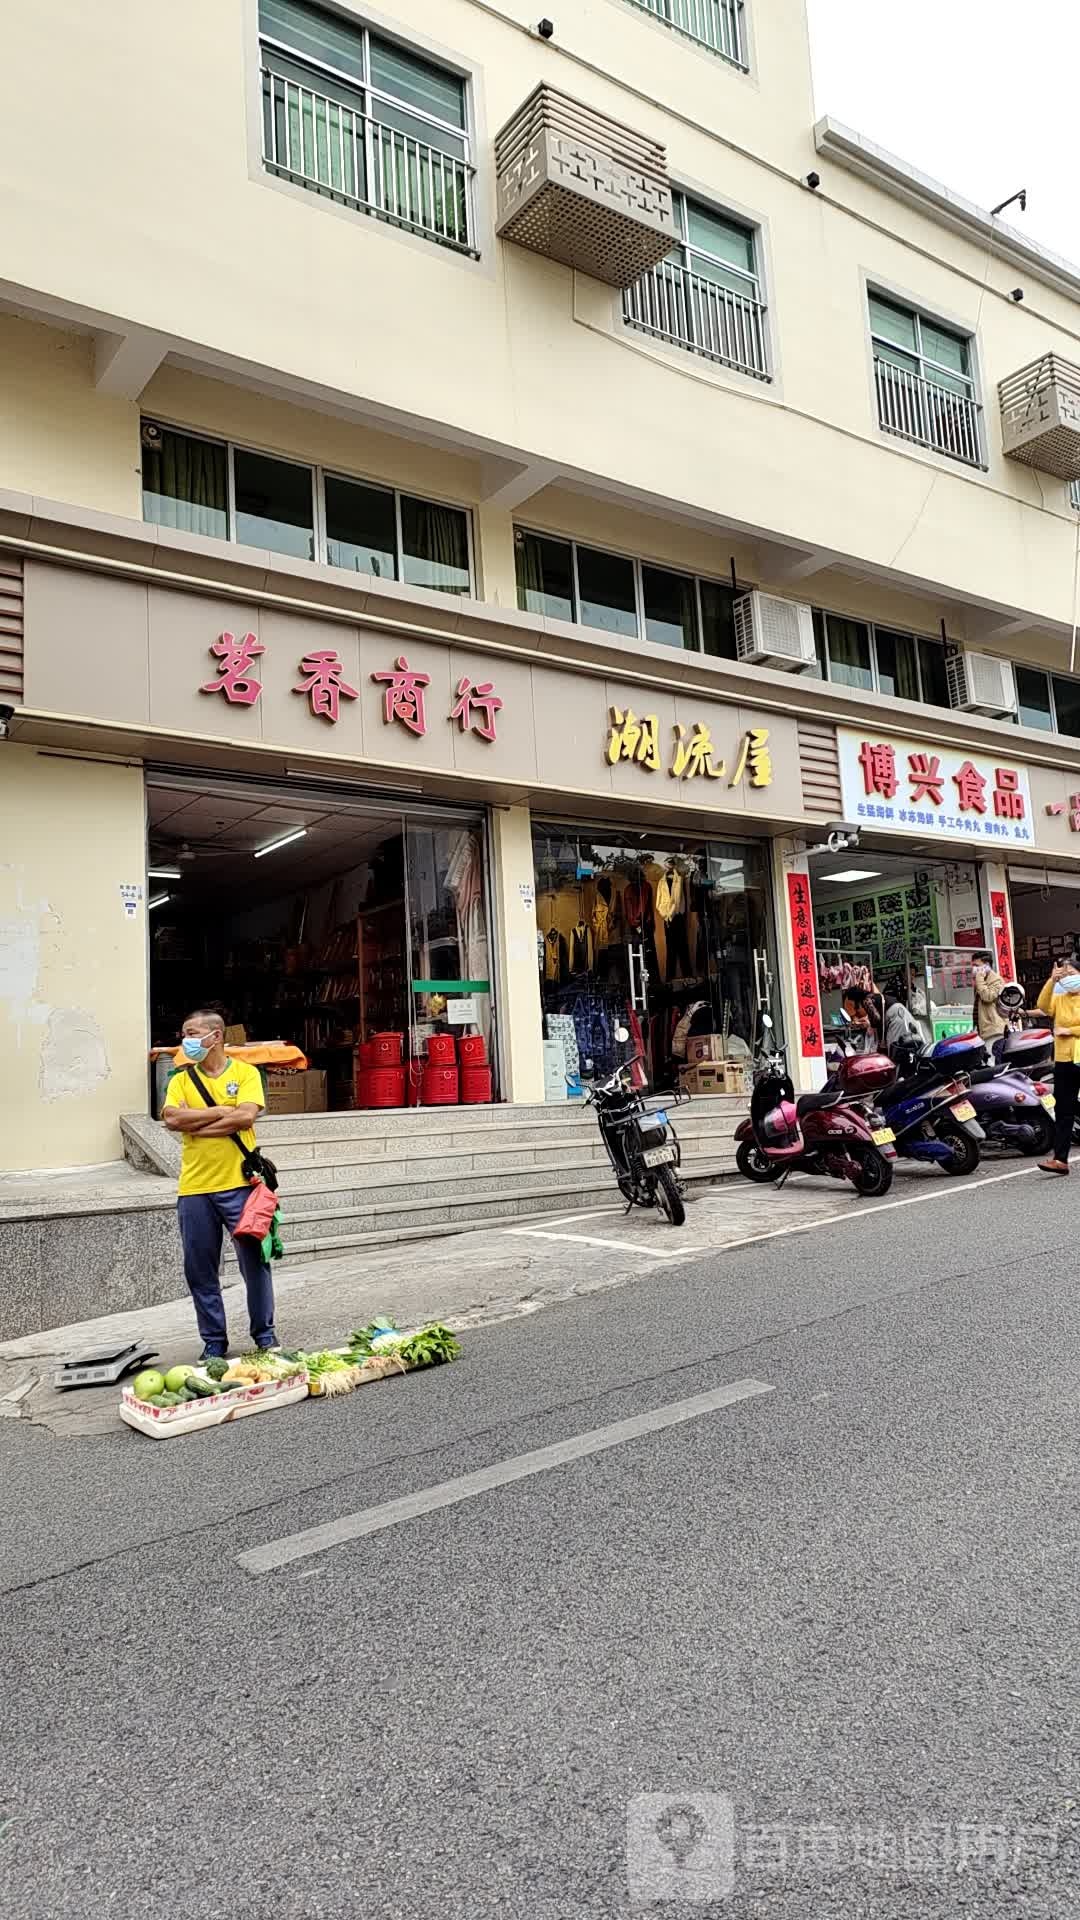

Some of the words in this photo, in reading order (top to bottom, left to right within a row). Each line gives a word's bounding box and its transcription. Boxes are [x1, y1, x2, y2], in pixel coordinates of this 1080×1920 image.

[199, 631, 505, 743] 茗香商行
[606, 705, 774, 788] 潮流屋
[858, 741, 1026, 819] 博兴食品
